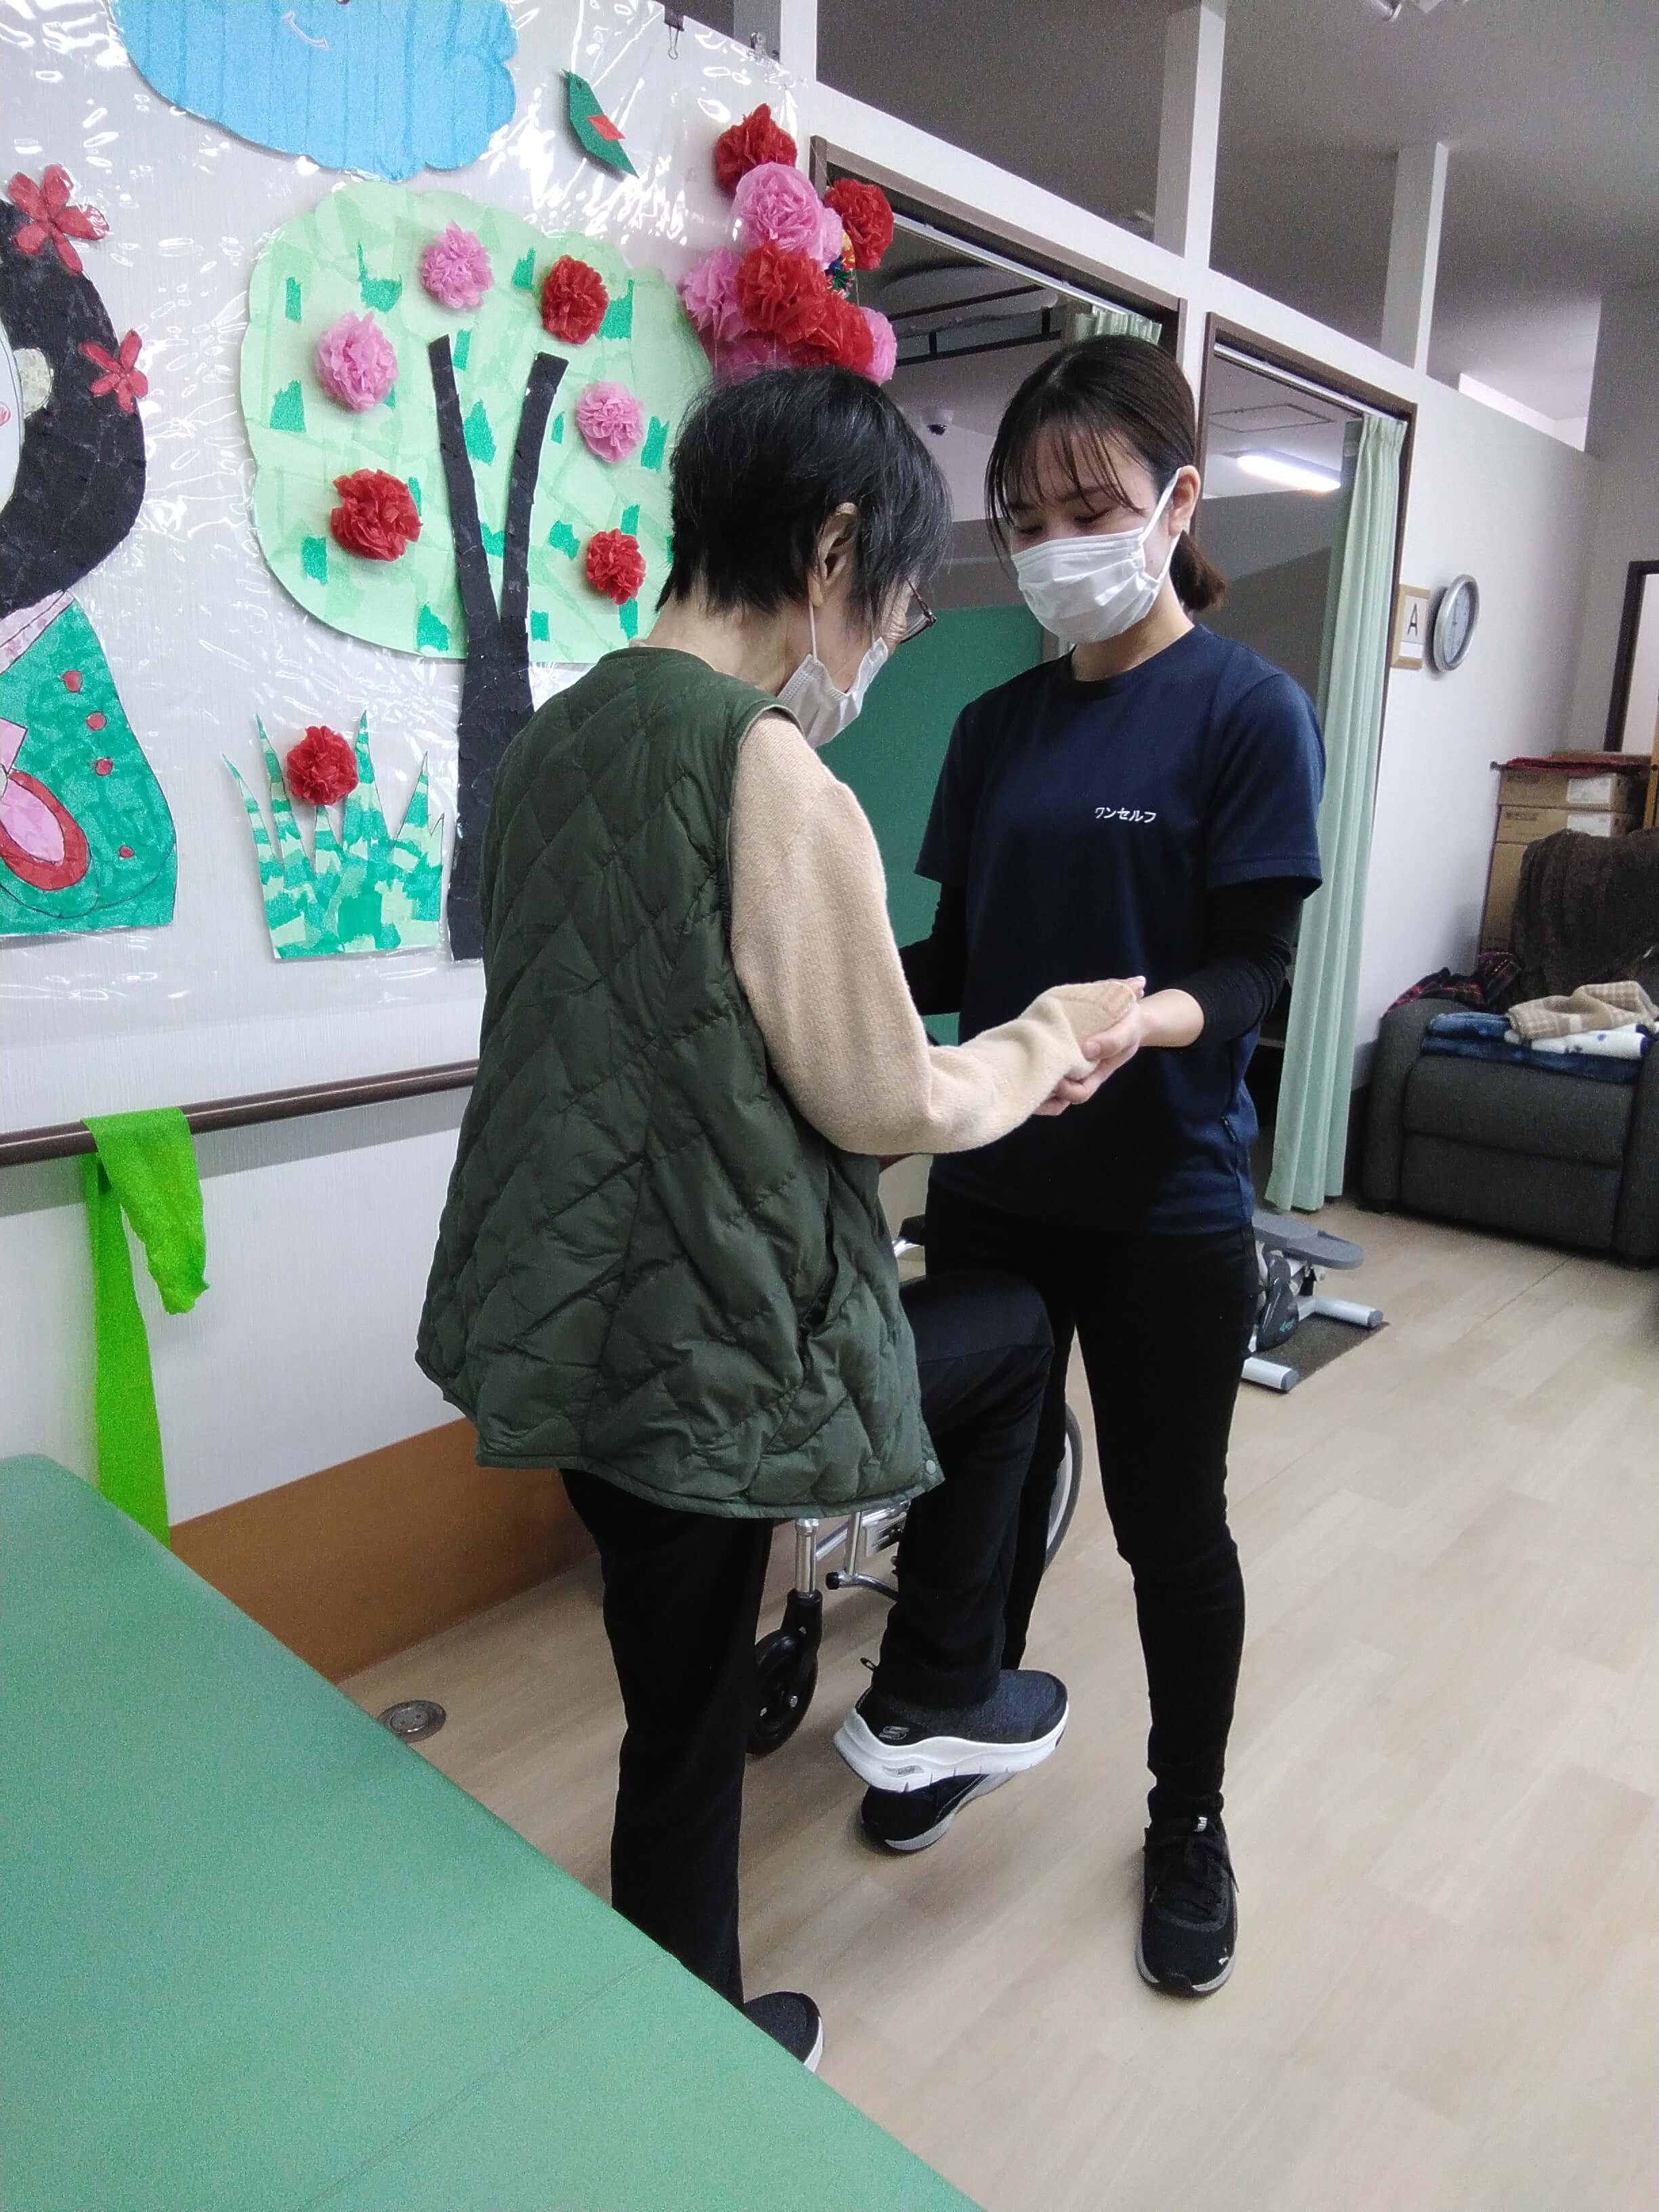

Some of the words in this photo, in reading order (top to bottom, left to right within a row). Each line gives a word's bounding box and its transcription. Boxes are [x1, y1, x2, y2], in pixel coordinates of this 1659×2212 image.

[1407, 602, 1418, 636] A
[1094, 806, 1156, 823] ワンセルフ
